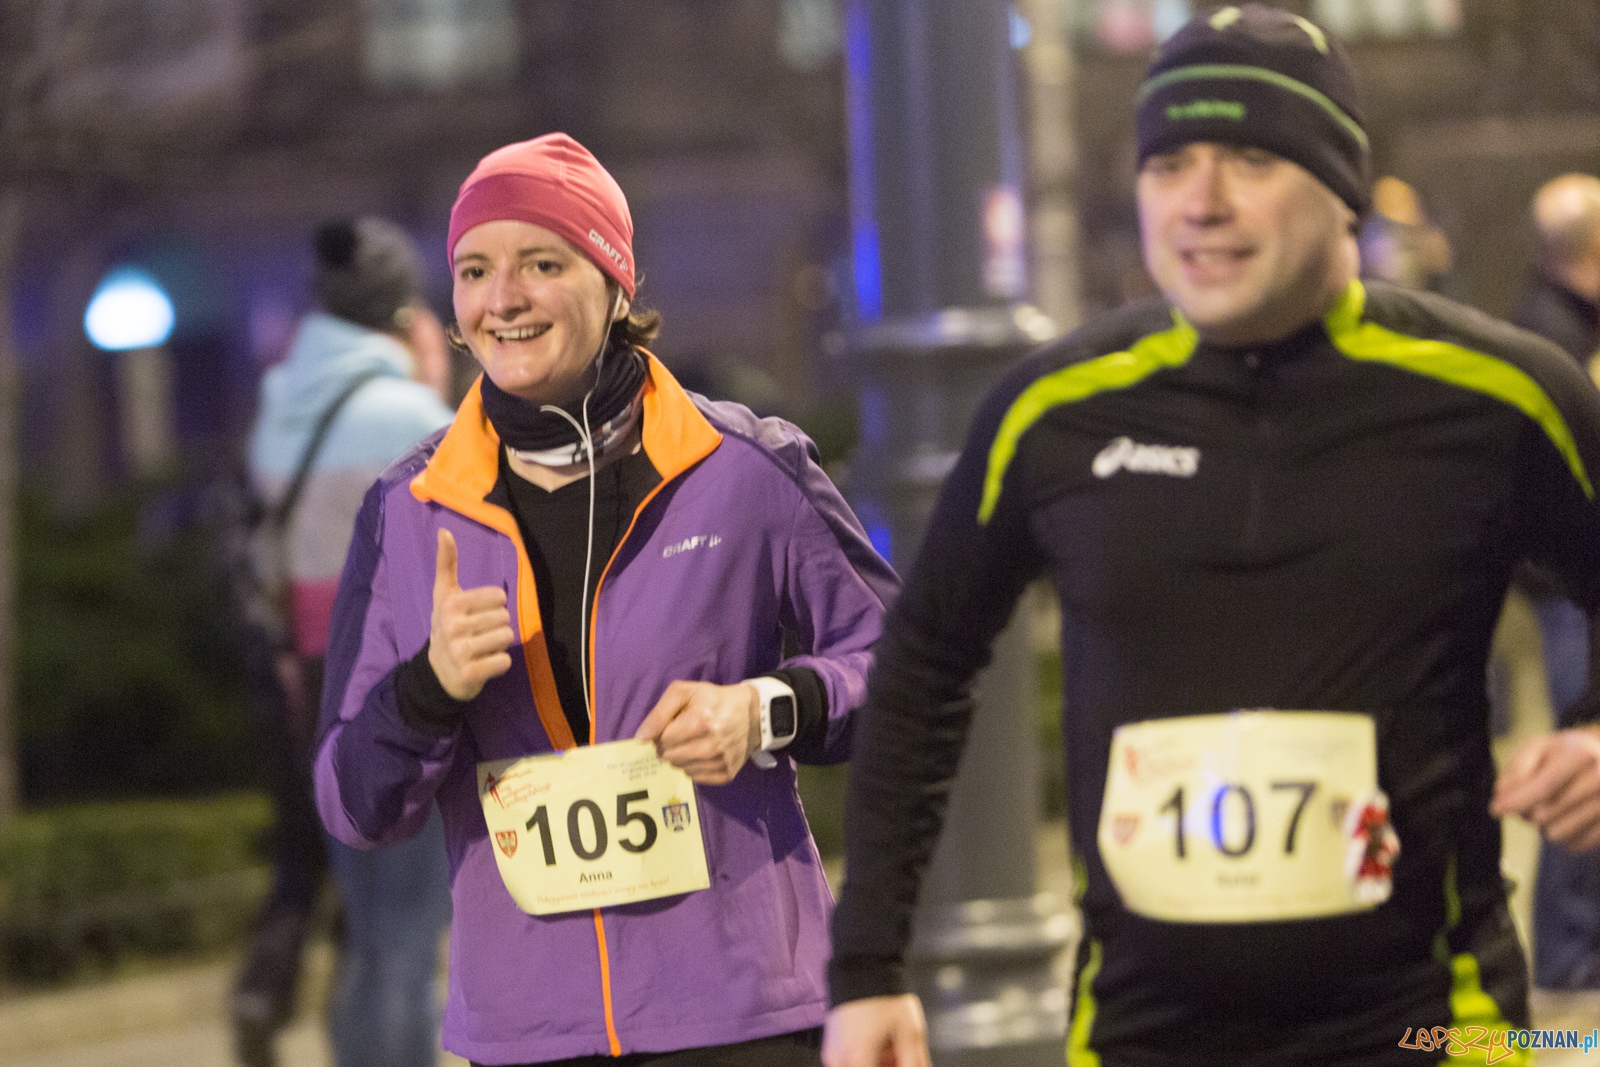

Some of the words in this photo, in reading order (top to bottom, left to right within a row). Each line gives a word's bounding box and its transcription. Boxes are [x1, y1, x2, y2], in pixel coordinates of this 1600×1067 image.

[588, 228, 622, 263] CRAFT
[662, 535, 708, 558] CRAFT
[525, 790, 658, 868] 105
[1158, 781, 1318, 859] 107
[579, 871, 614, 885] Anna
